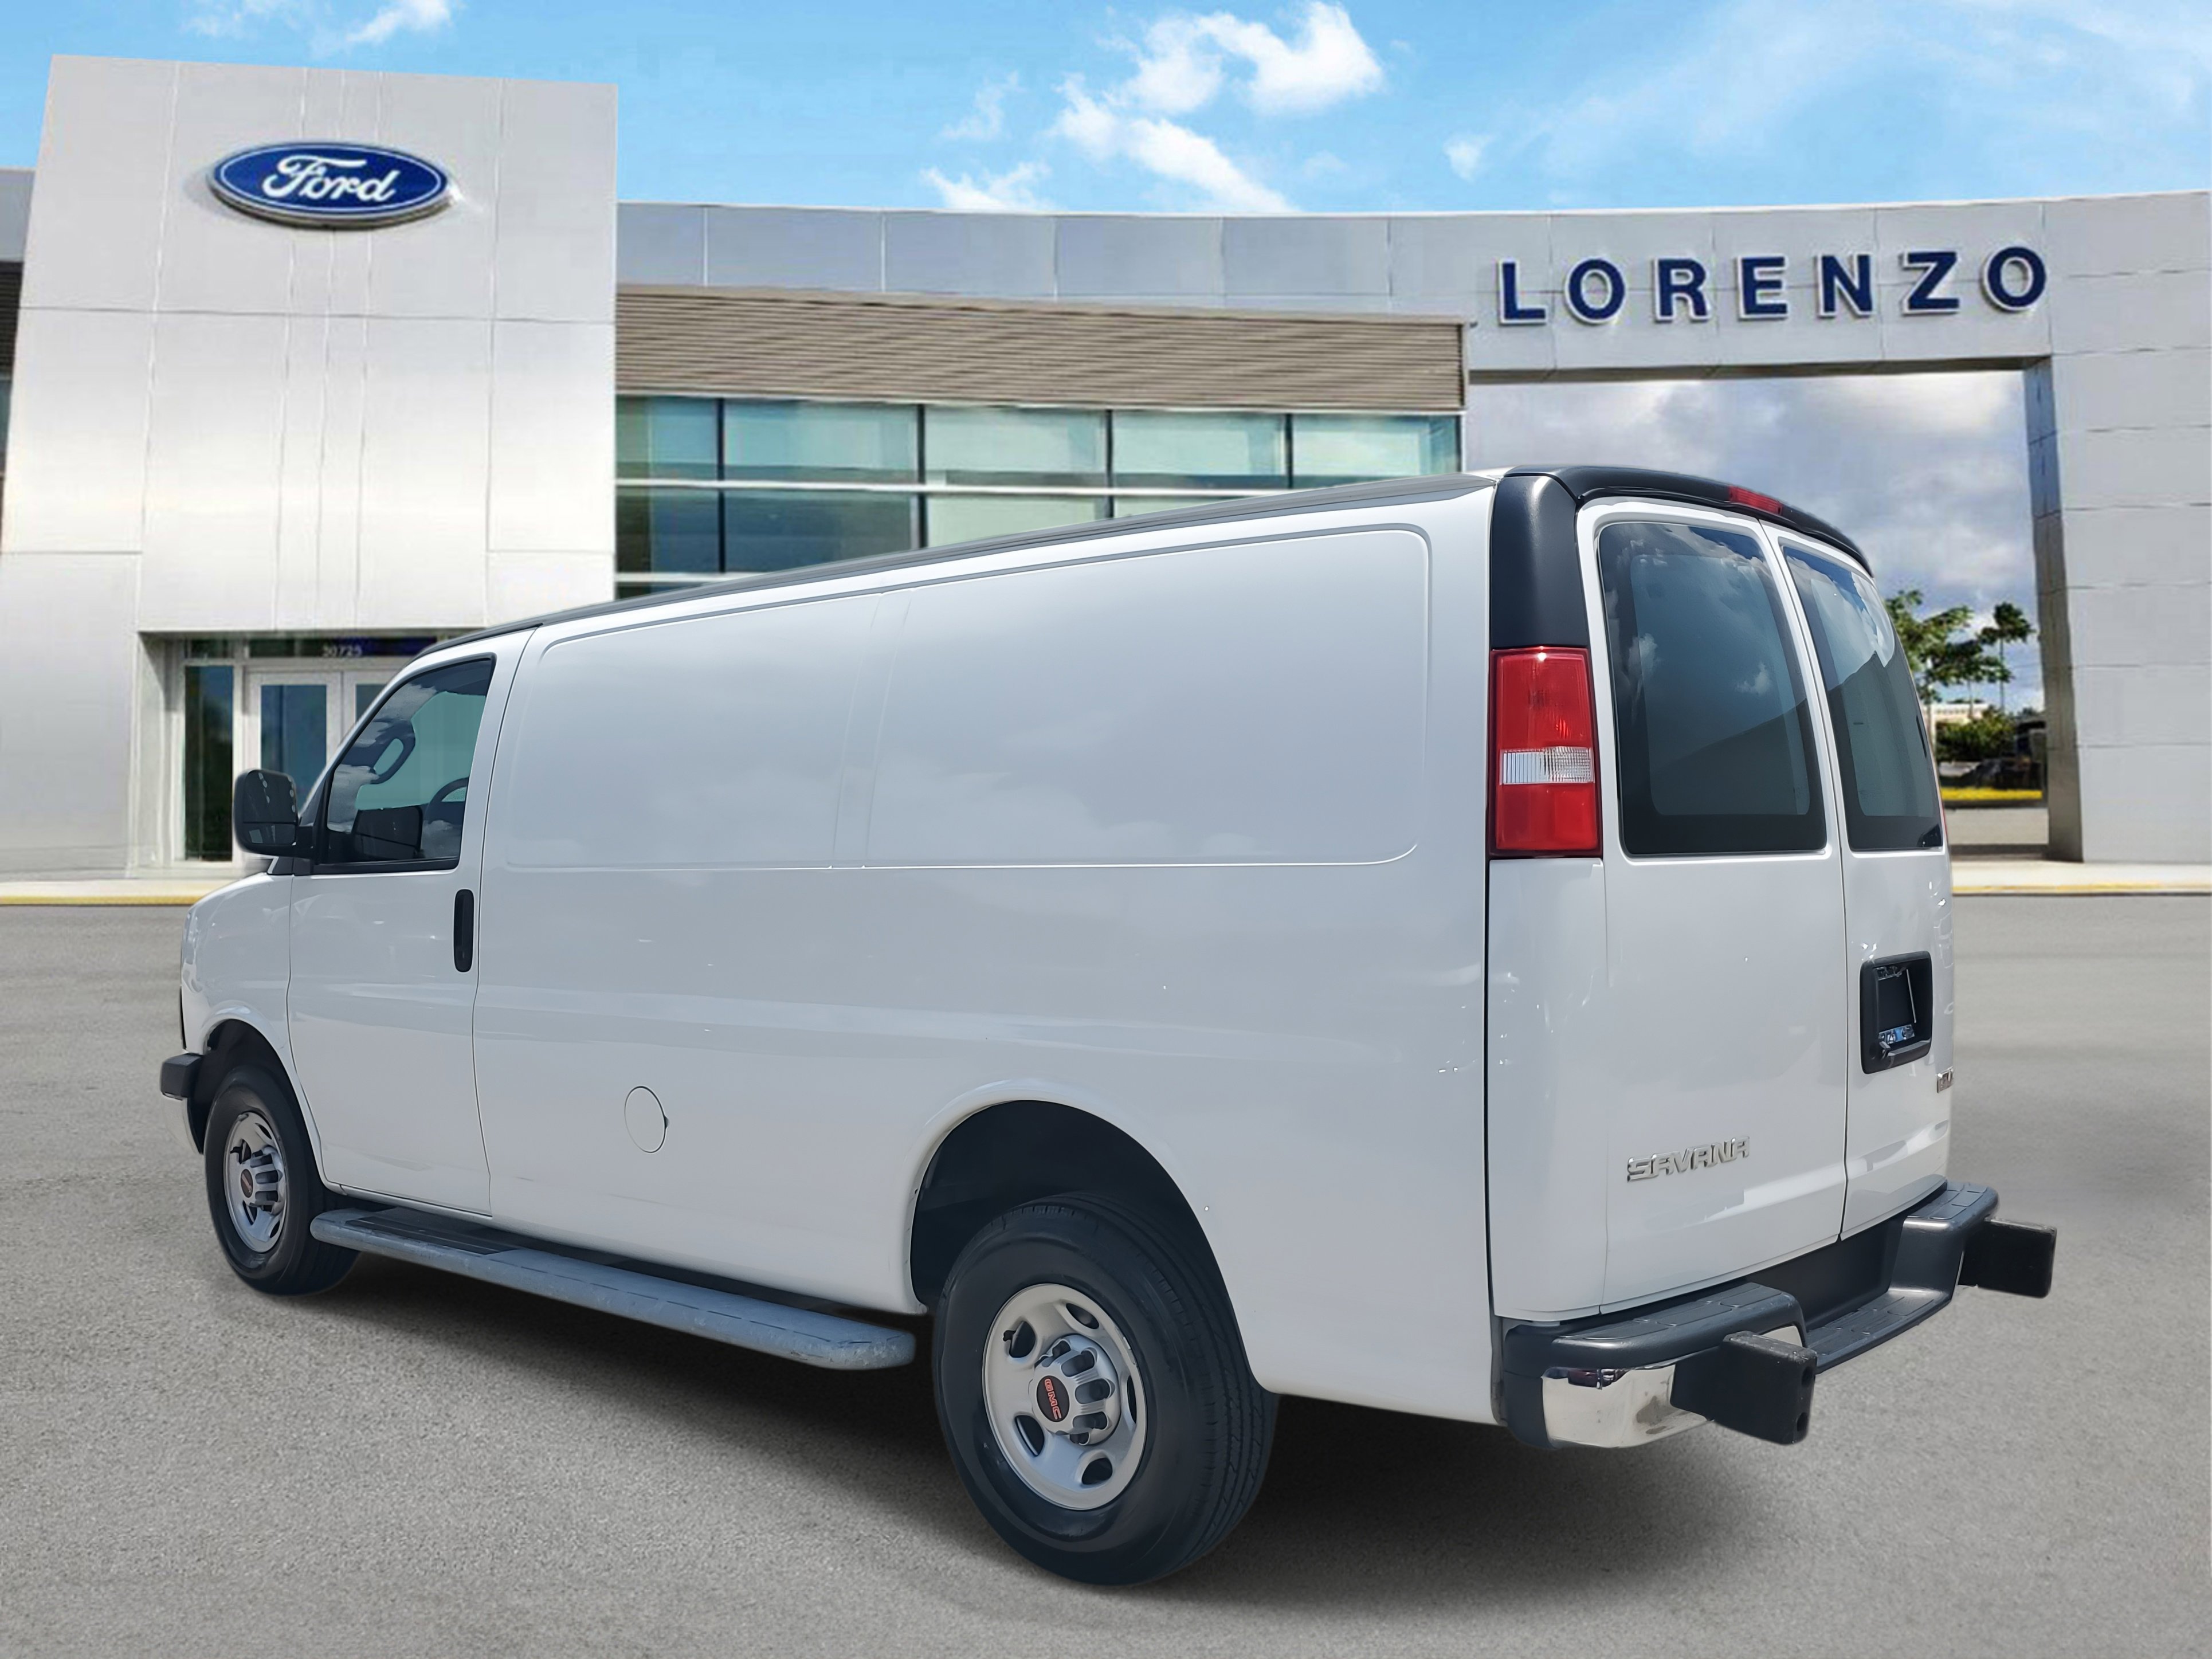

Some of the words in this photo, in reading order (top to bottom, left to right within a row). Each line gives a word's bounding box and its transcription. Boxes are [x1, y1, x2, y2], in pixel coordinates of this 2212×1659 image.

[262, 154, 400, 202] Ford
[1497, 246, 2047, 324] LORENZO
[1627, 1136, 1750, 1182] SAVANA
[1044, 1378, 1062, 1419] GMC
